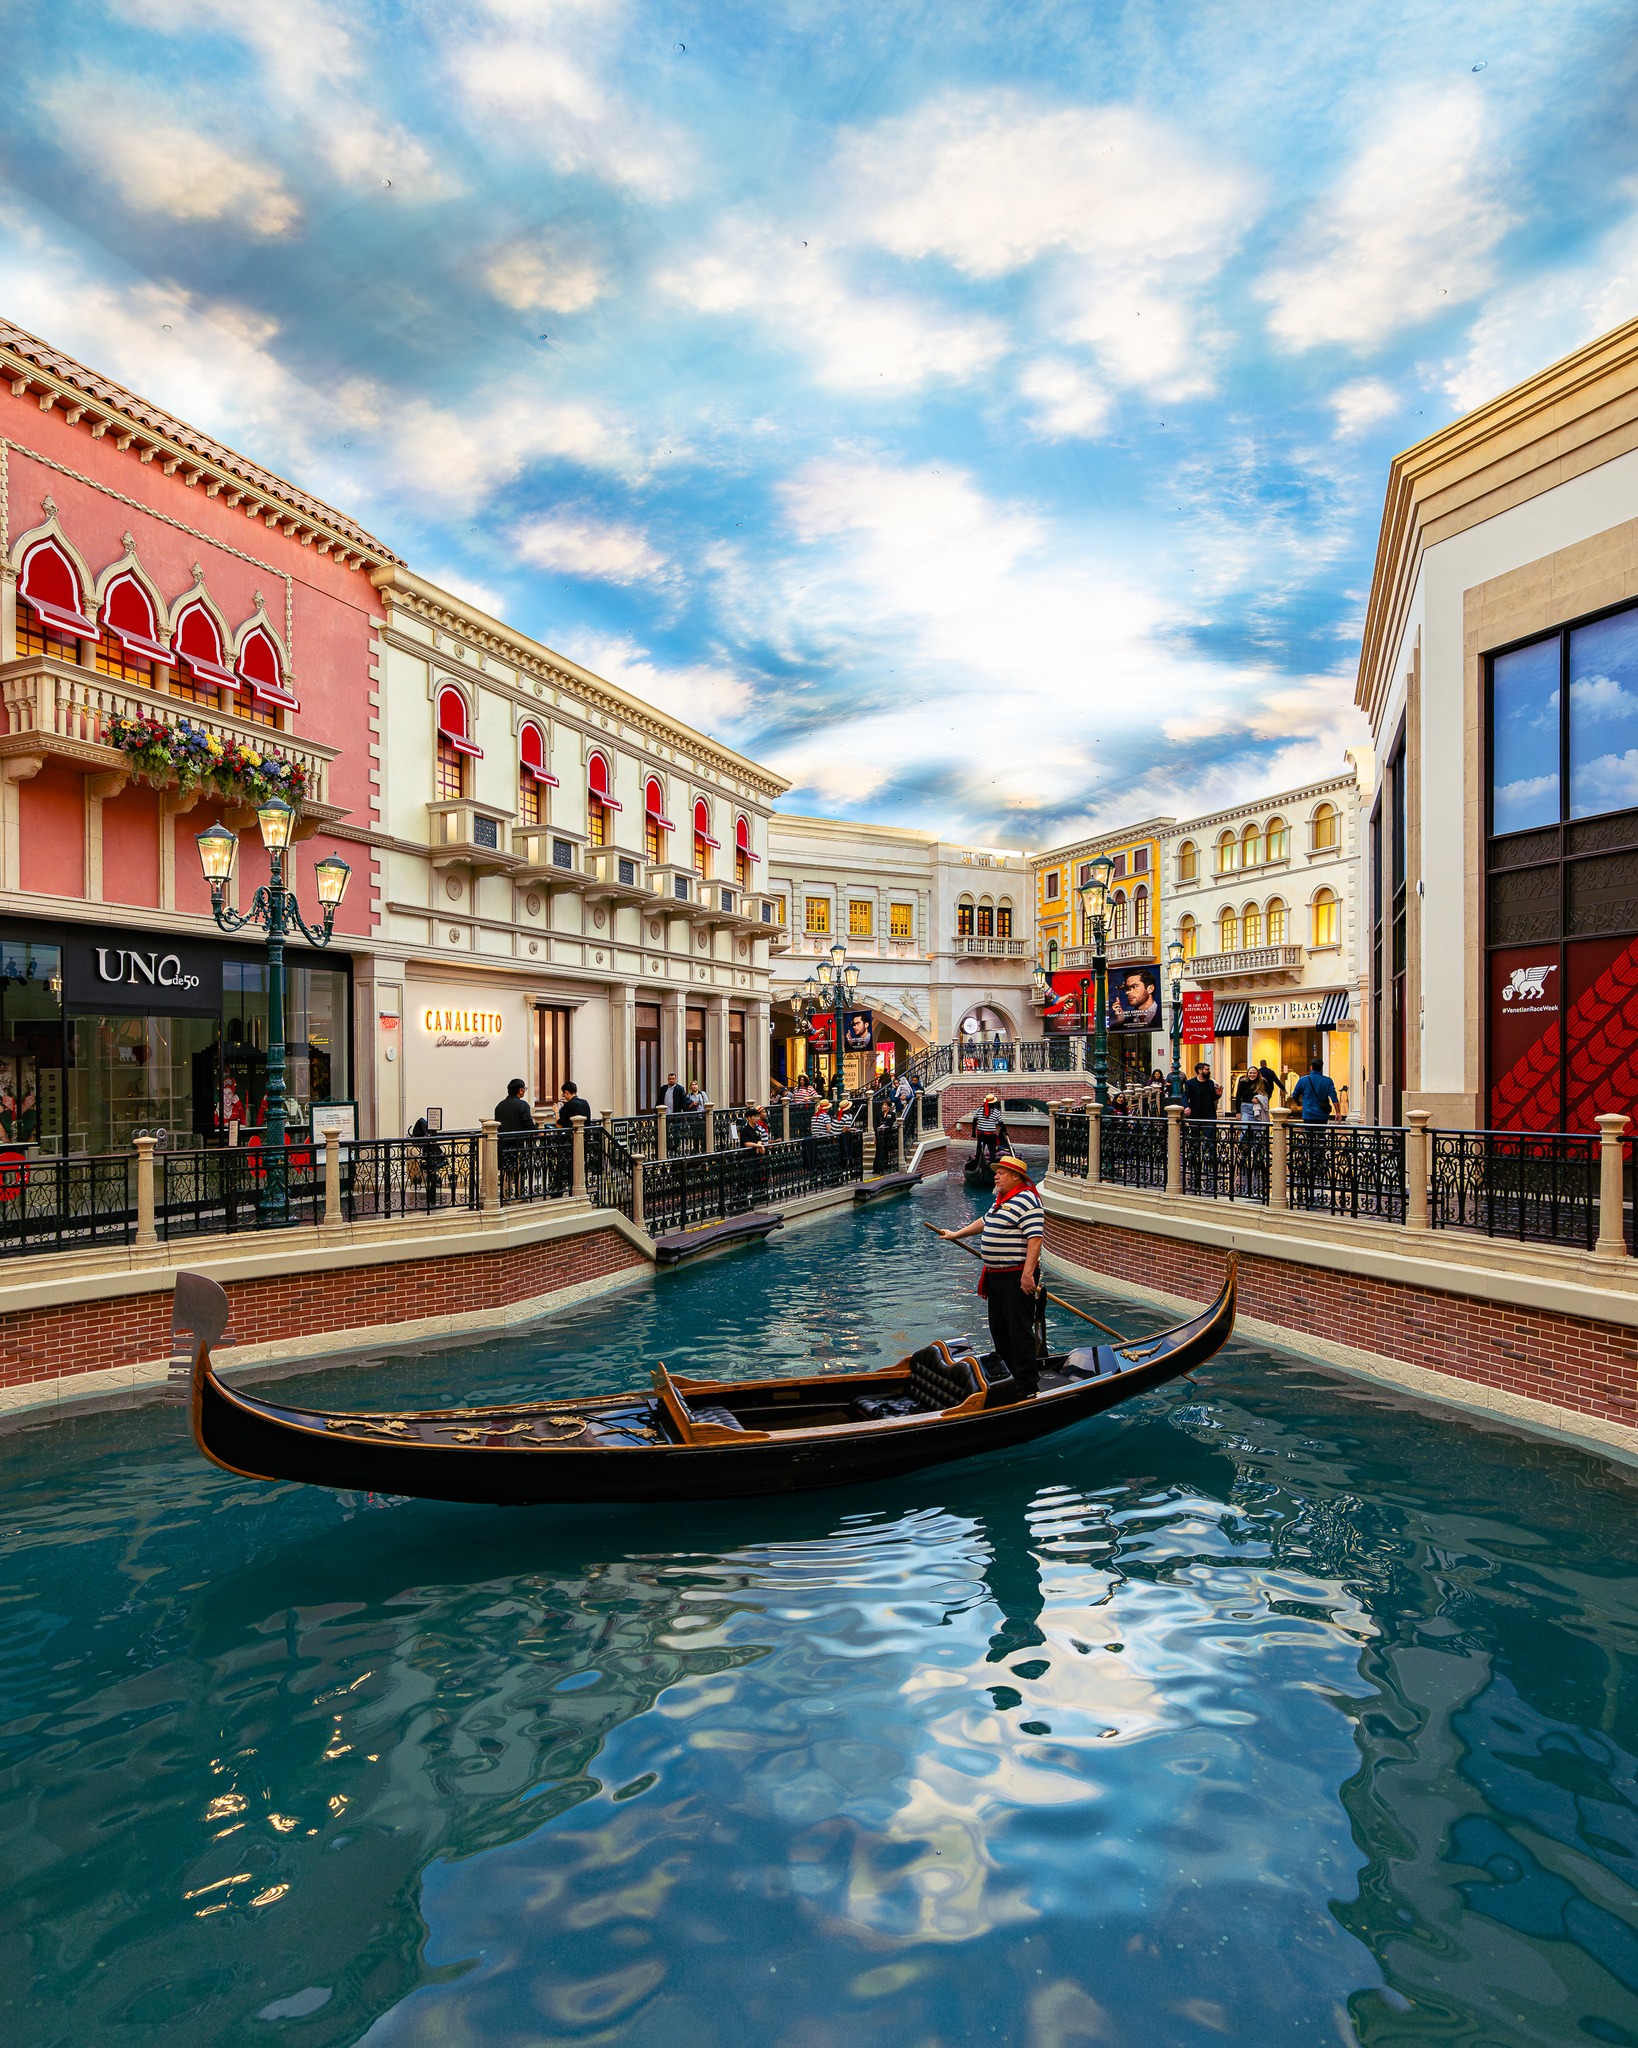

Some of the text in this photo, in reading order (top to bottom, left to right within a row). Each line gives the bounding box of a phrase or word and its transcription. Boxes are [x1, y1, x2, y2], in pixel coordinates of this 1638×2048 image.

[1249, 1005, 1280, 1015] WHITE
[1502, 1005, 1559, 1013] #VenetianRaceWeek
[425, 1010, 502, 1033] CANALETTO
[614, 1125, 627, 1133] EXIT
